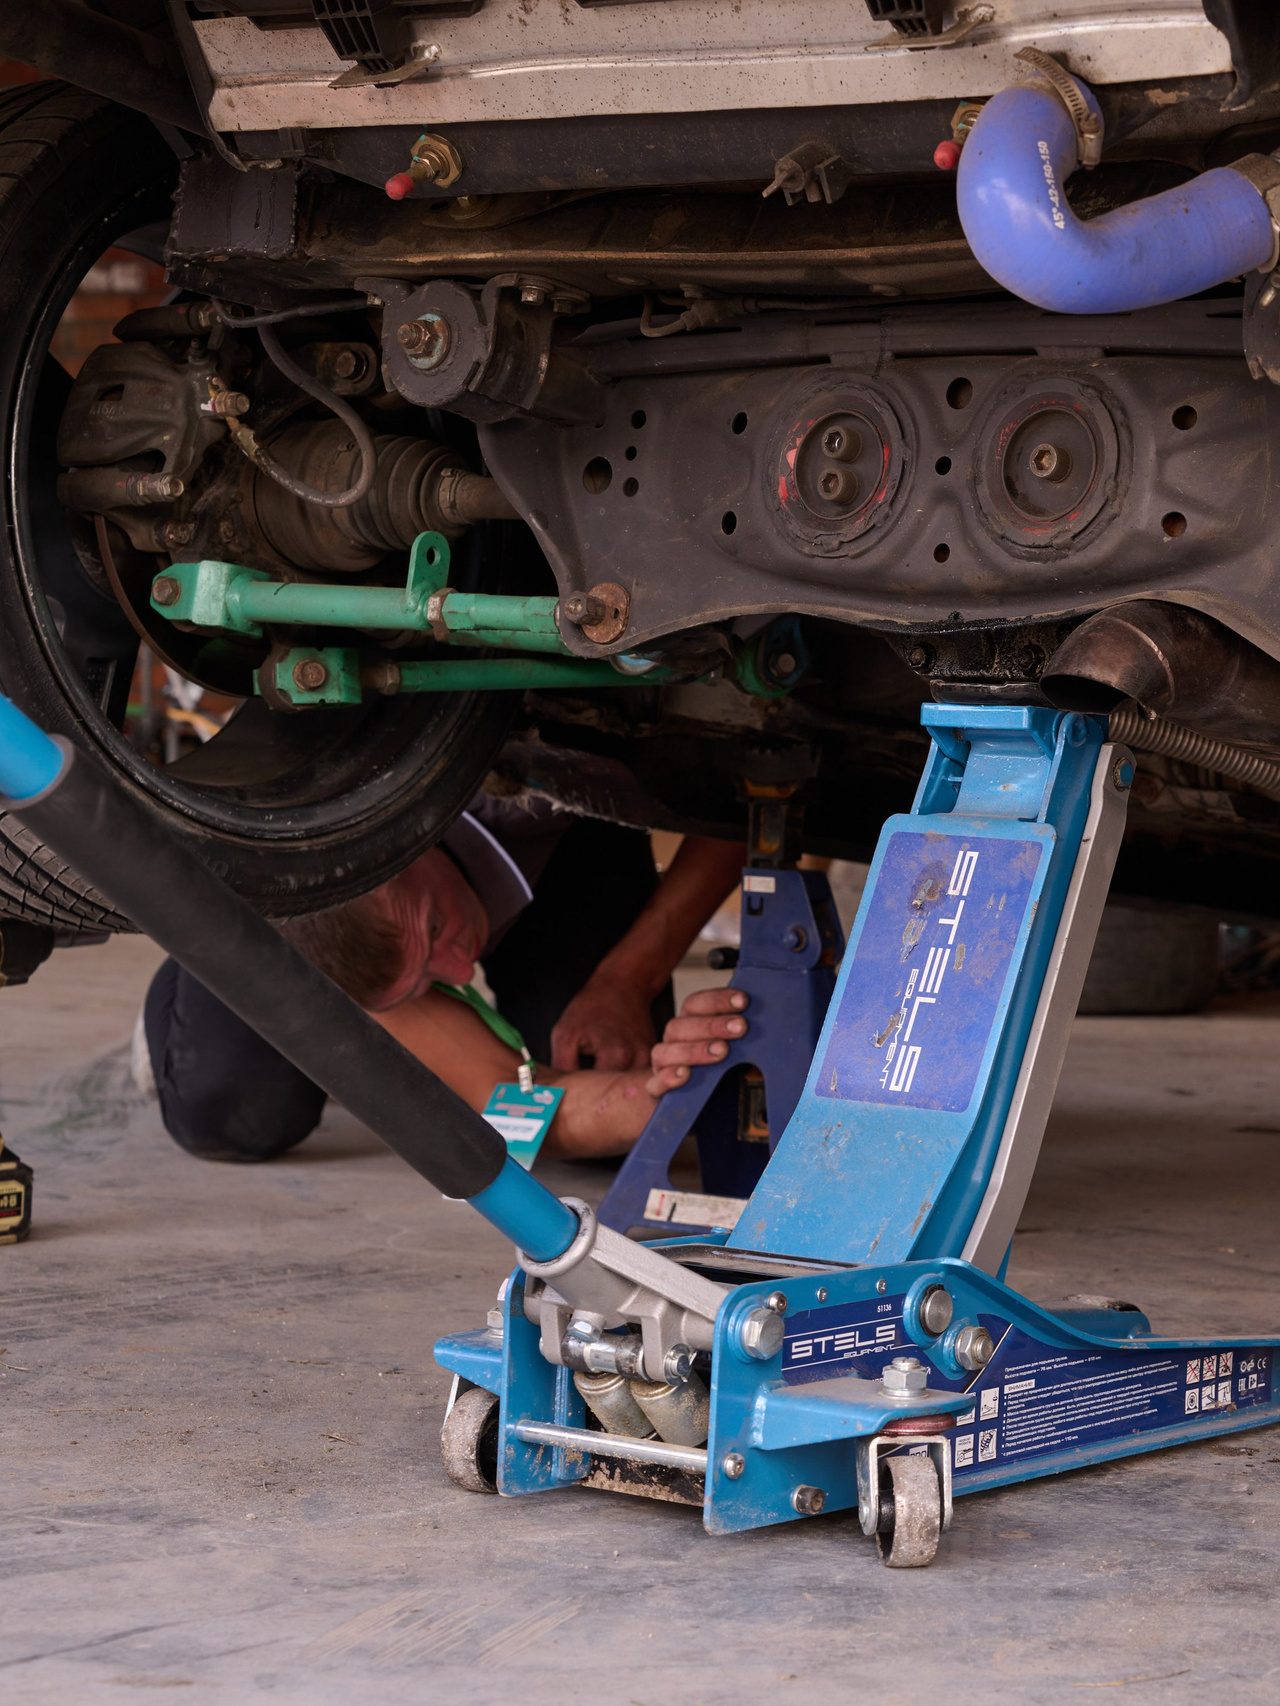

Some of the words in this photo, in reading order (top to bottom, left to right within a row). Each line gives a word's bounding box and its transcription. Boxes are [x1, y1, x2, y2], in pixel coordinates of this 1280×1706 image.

[889, 851, 979, 1092] STELS
[879, 969, 919, 1089] EQUIPMENT
[877, 1303, 892, 1313] 51136
[791, 1324, 896, 1359] STELS
[843, 1344, 894, 1359] EQUIPMENT
